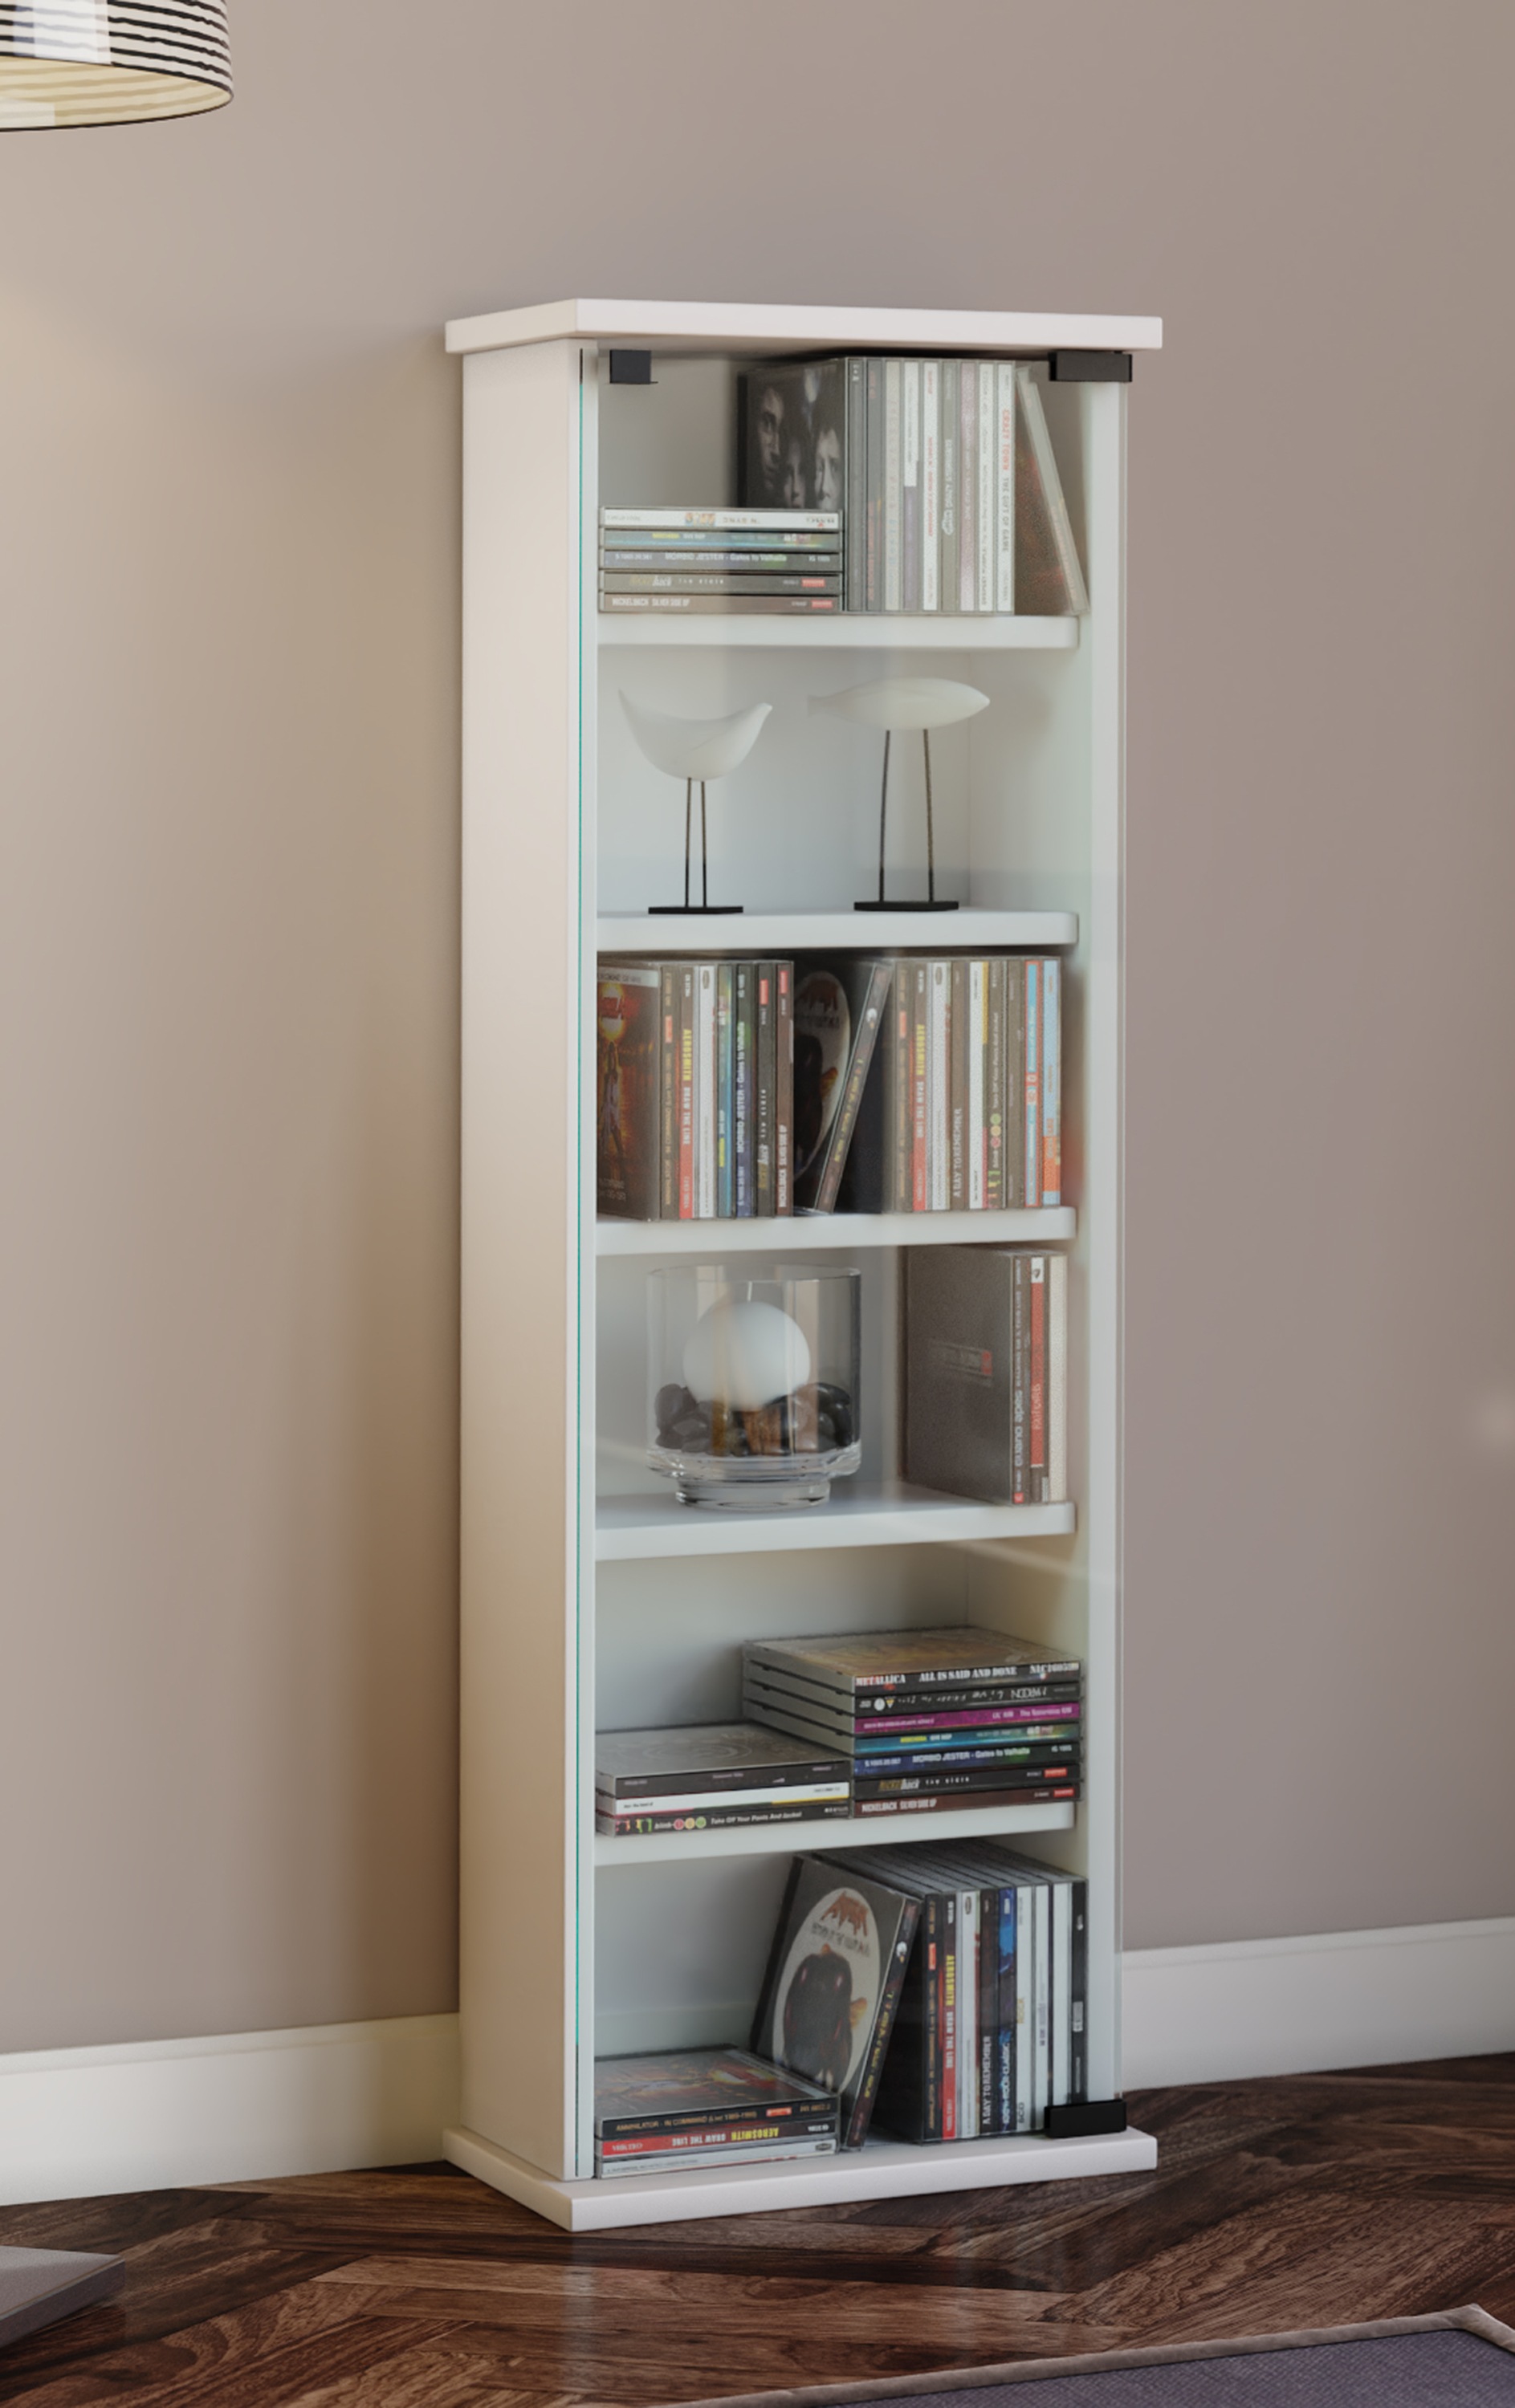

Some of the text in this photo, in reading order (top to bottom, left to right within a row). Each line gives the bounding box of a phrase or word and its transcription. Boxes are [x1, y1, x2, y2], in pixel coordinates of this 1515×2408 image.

[683, 1029, 692, 1080] AEROSMITH
[916, 1024, 925, 1076] AEROSMITH
[954, 1108, 963, 1157] REMEMBER
[954, 1158, 963, 1169] TO
[954, 1171, 963, 1189] DAY
[856, 1666, 1017, 1686] METALLICA ALL IS SAID AND DONE
[913, 1755, 942, 1763] MORBID
[943, 1752, 970, 1760] JESTER
[975, 1751, 995, 1759] Gates
[996, 1749, 1003, 1757] to
[1004, 1747, 1030, 1756] Valhalla
[861, 1802, 897, 1812] NICKELBACK
[900, 1800, 917, 1810] SILVER
[946, 1954, 954, 2068] AEROSMITH DRAW THE LINE
[983, 2036, 992, 2085] REMEMBER
[983, 2085, 992, 2097] TO
[983, 2099, 992, 2117] DAY
[617, 2121, 658, 2132] ANNIHILATOR
[672, 2116, 707, 2125] COMMAND
[672, 2128, 779, 2146] AEROSMITH DRAW THE LINE
